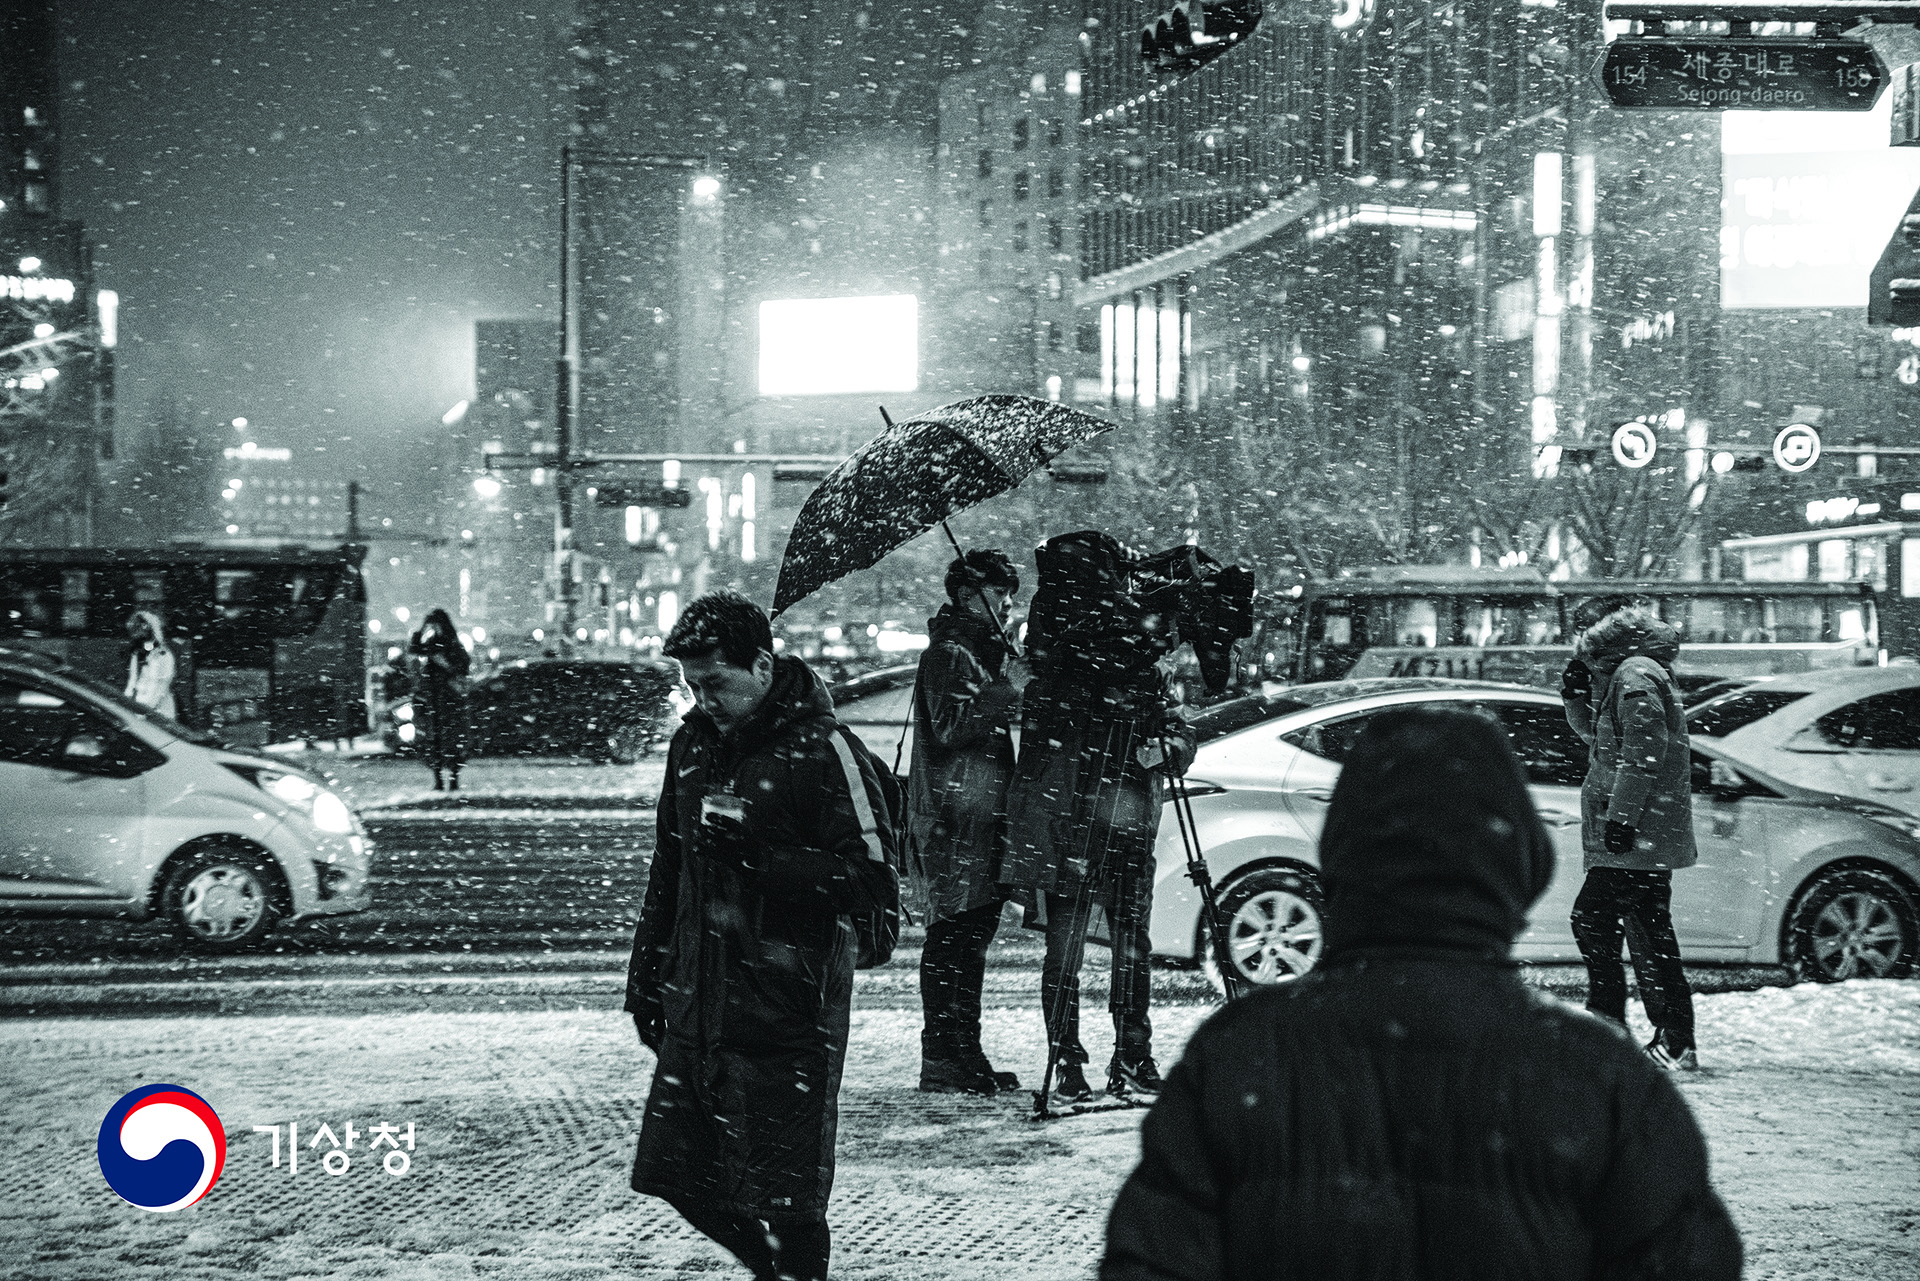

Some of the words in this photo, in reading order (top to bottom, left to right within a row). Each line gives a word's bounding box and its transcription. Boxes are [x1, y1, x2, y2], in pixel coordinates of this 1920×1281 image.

[1682, 51, 1799, 79] 세종대로
[1612, 66, 1647, 85] 154
[1677, 84, 1804, 104] Sejong-daero
